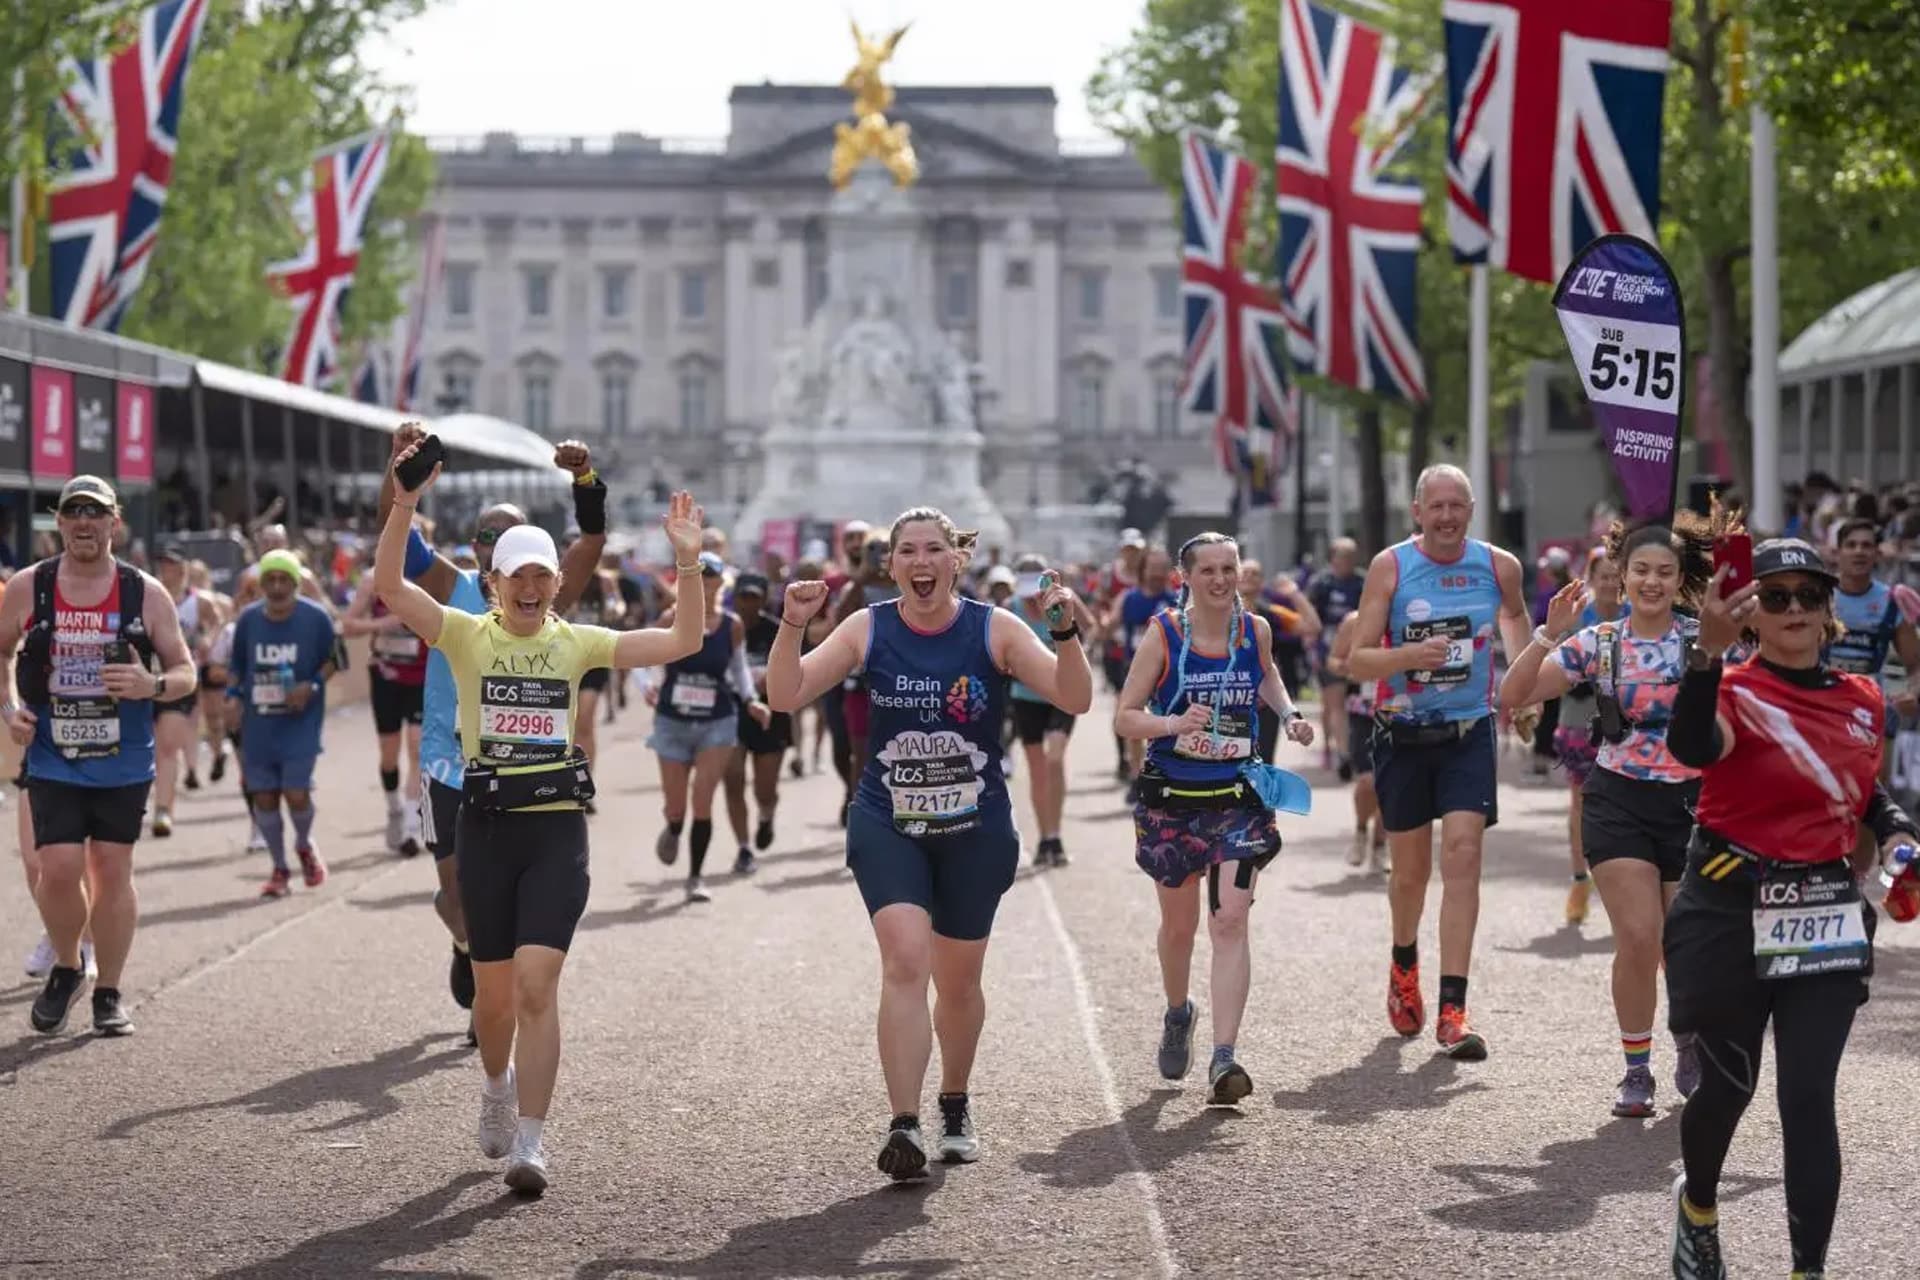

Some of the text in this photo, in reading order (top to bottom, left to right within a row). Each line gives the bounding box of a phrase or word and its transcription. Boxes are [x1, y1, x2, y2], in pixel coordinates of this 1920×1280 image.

[1614, 282, 1664, 296] MARATHON
[1616, 273, 1654, 286] LONDON
[1612, 290, 1645, 304] EVENTS
[1601, 327, 1624, 342] SUB
[1590, 343, 1676, 400] 5:15
[1616, 428, 1674, 450] INSPIRING
[1614, 443, 1669, 463] ACTIVITY
[55, 611, 103, 629] MARTIN
[256, 643, 297, 664] LDN
[492, 653, 556, 674] ALYX
[487, 681, 541, 702] tcs TATA
[896, 675, 941, 692] Brain
[871, 688, 941, 708] Research
[495, 713, 554, 736] 22996
[920, 710, 942, 723] UK
[61, 725, 109, 741] 65235
[896, 736, 961, 757] MAURA
[894, 763, 924, 784] tcs
[904, 791, 963, 812] 72177
[1770, 913, 1845, 943] 47877
[1800, 962, 1819, 971] new
[1821, 958, 1861, 969] balance
